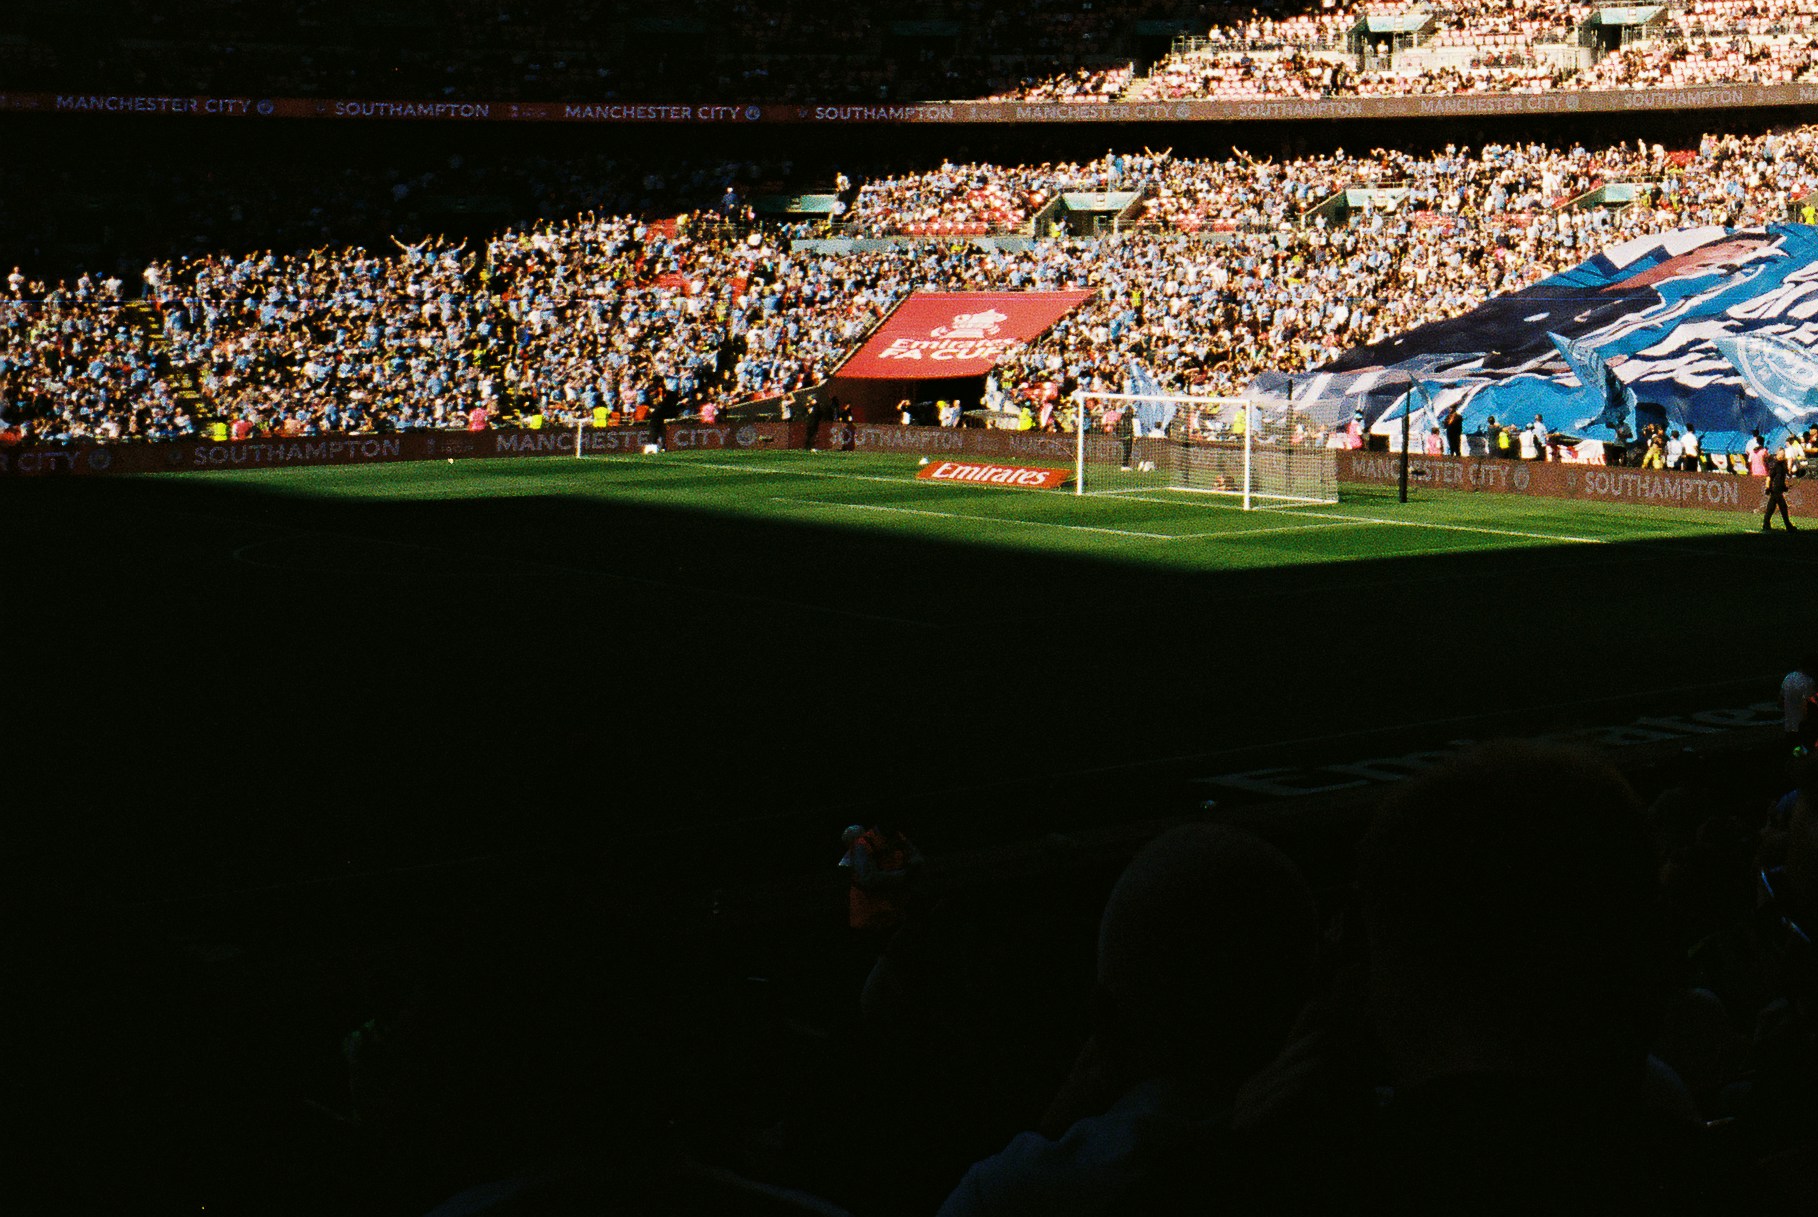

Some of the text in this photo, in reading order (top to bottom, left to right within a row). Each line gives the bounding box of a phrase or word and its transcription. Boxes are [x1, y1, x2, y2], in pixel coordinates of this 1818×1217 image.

[56, 95, 197, 114] MANCHESTER
[205, 97, 251, 116] CITY
[1239, 100, 1363, 117] SOUTHAMPTON
[1420, 95, 1567, 113] MANCHESTER CITY
[1624, 89, 1743, 109] SOUTHAMPTON
[334, 101, 490, 119] SOUTHAMPTON
[564, 104, 692, 120] MANCHESTER
[697, 105, 741, 121] CITY
[815, 106, 954, 121] SOUTHAMPTON
[1016, 103, 1174, 119] MANCHESTER CITY
[878, 347, 923, 360] FA
[673, 428, 730, 447] CITY
[17, 451, 81, 471] CITY
[194, 438, 401, 467] SOUTHAMPTON
[931, 462, 1050, 485] Emirates
[1468, 462, 1510, 487] CITY
[1585, 469, 1739, 505] SOUTHAMPTON
